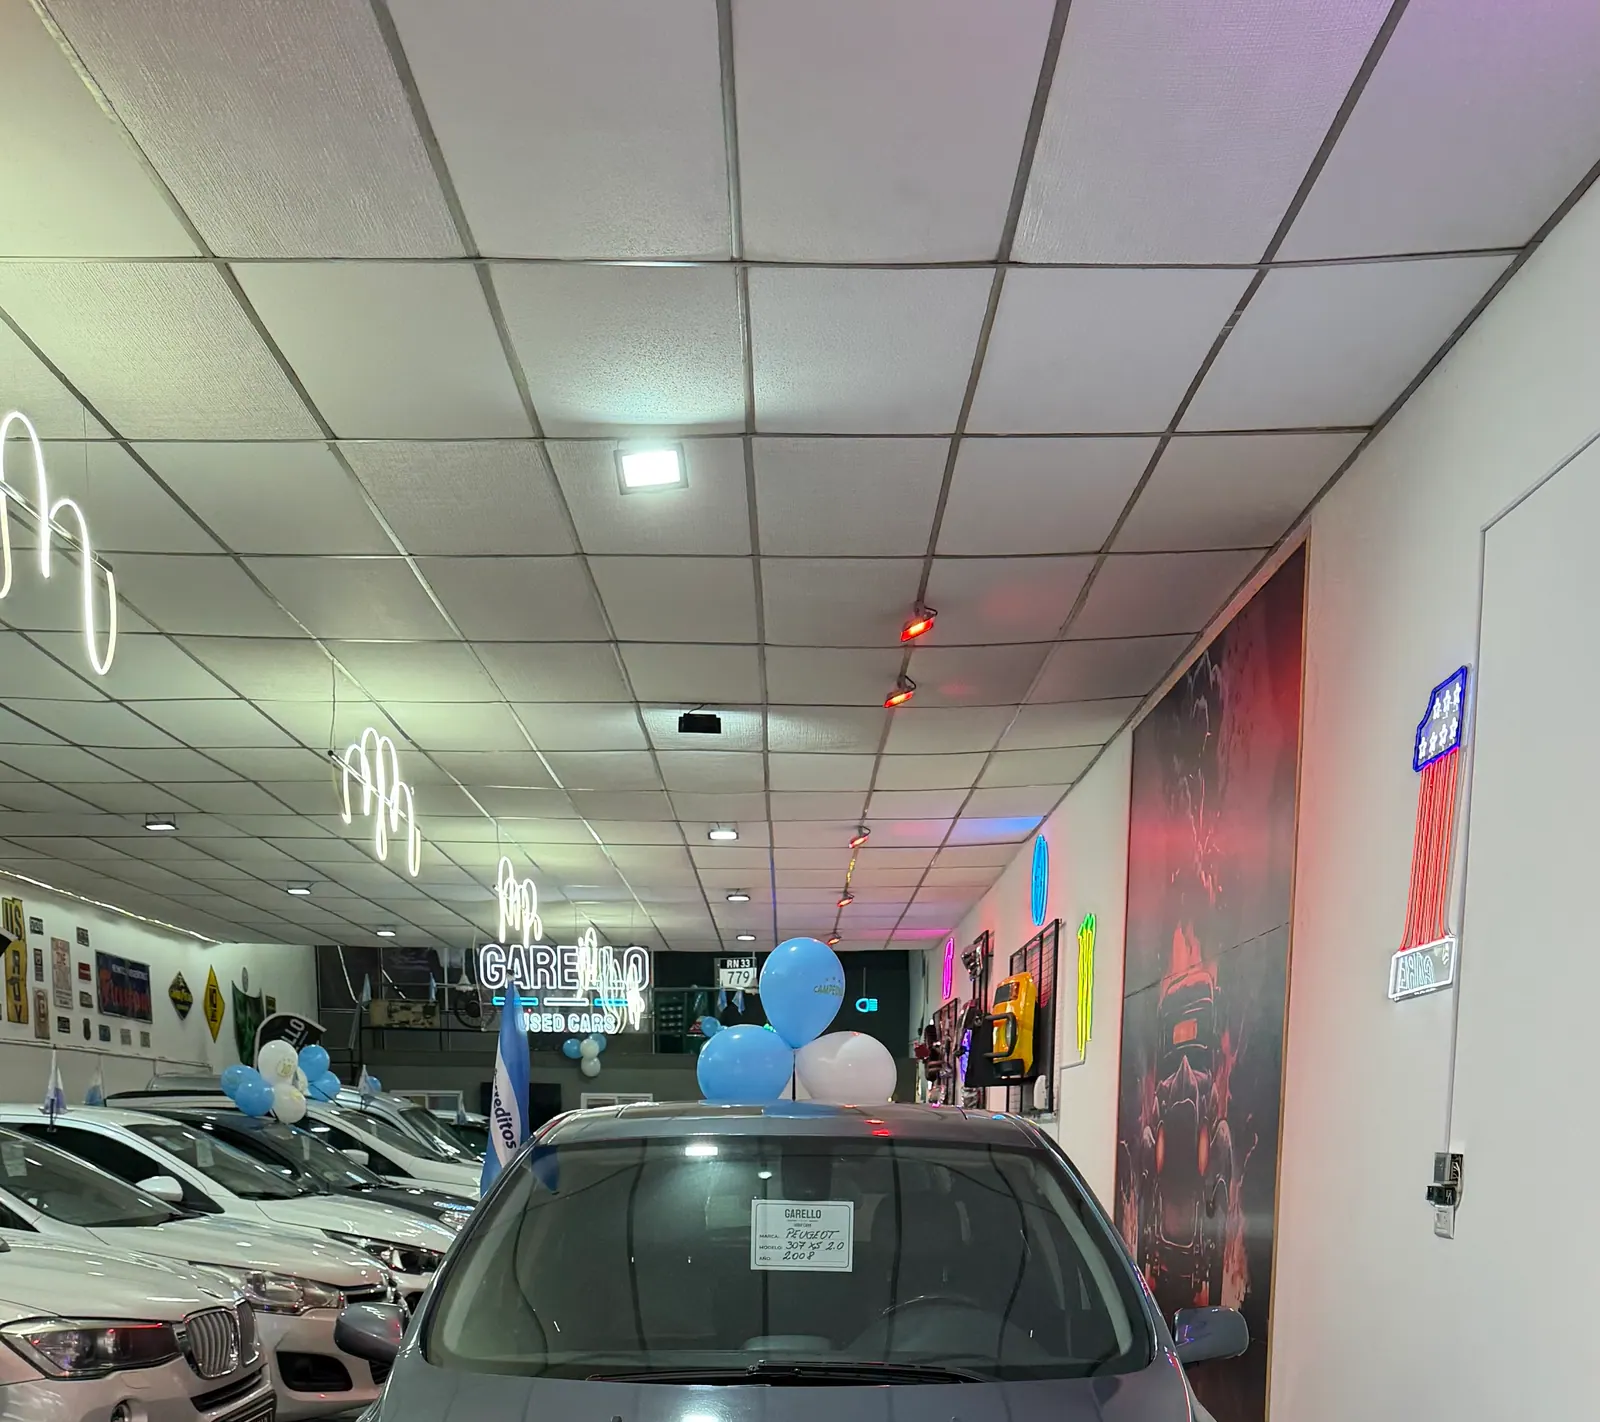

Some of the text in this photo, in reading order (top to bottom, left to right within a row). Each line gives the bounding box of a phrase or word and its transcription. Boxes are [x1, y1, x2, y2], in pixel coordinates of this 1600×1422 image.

[726, 959, 751, 968] RN 33
[727, 971, 750, 984] 779
[519, 1013, 617, 1034] USED CARS
[785, 1208, 822, 1219] GARELLO
[785, 1227, 840, 1240] PEUGEOT
[785, 1241, 806, 1250] 307
[825, 1241, 845, 1250] 2.0
[782, 1251, 815, 1260] 2008
